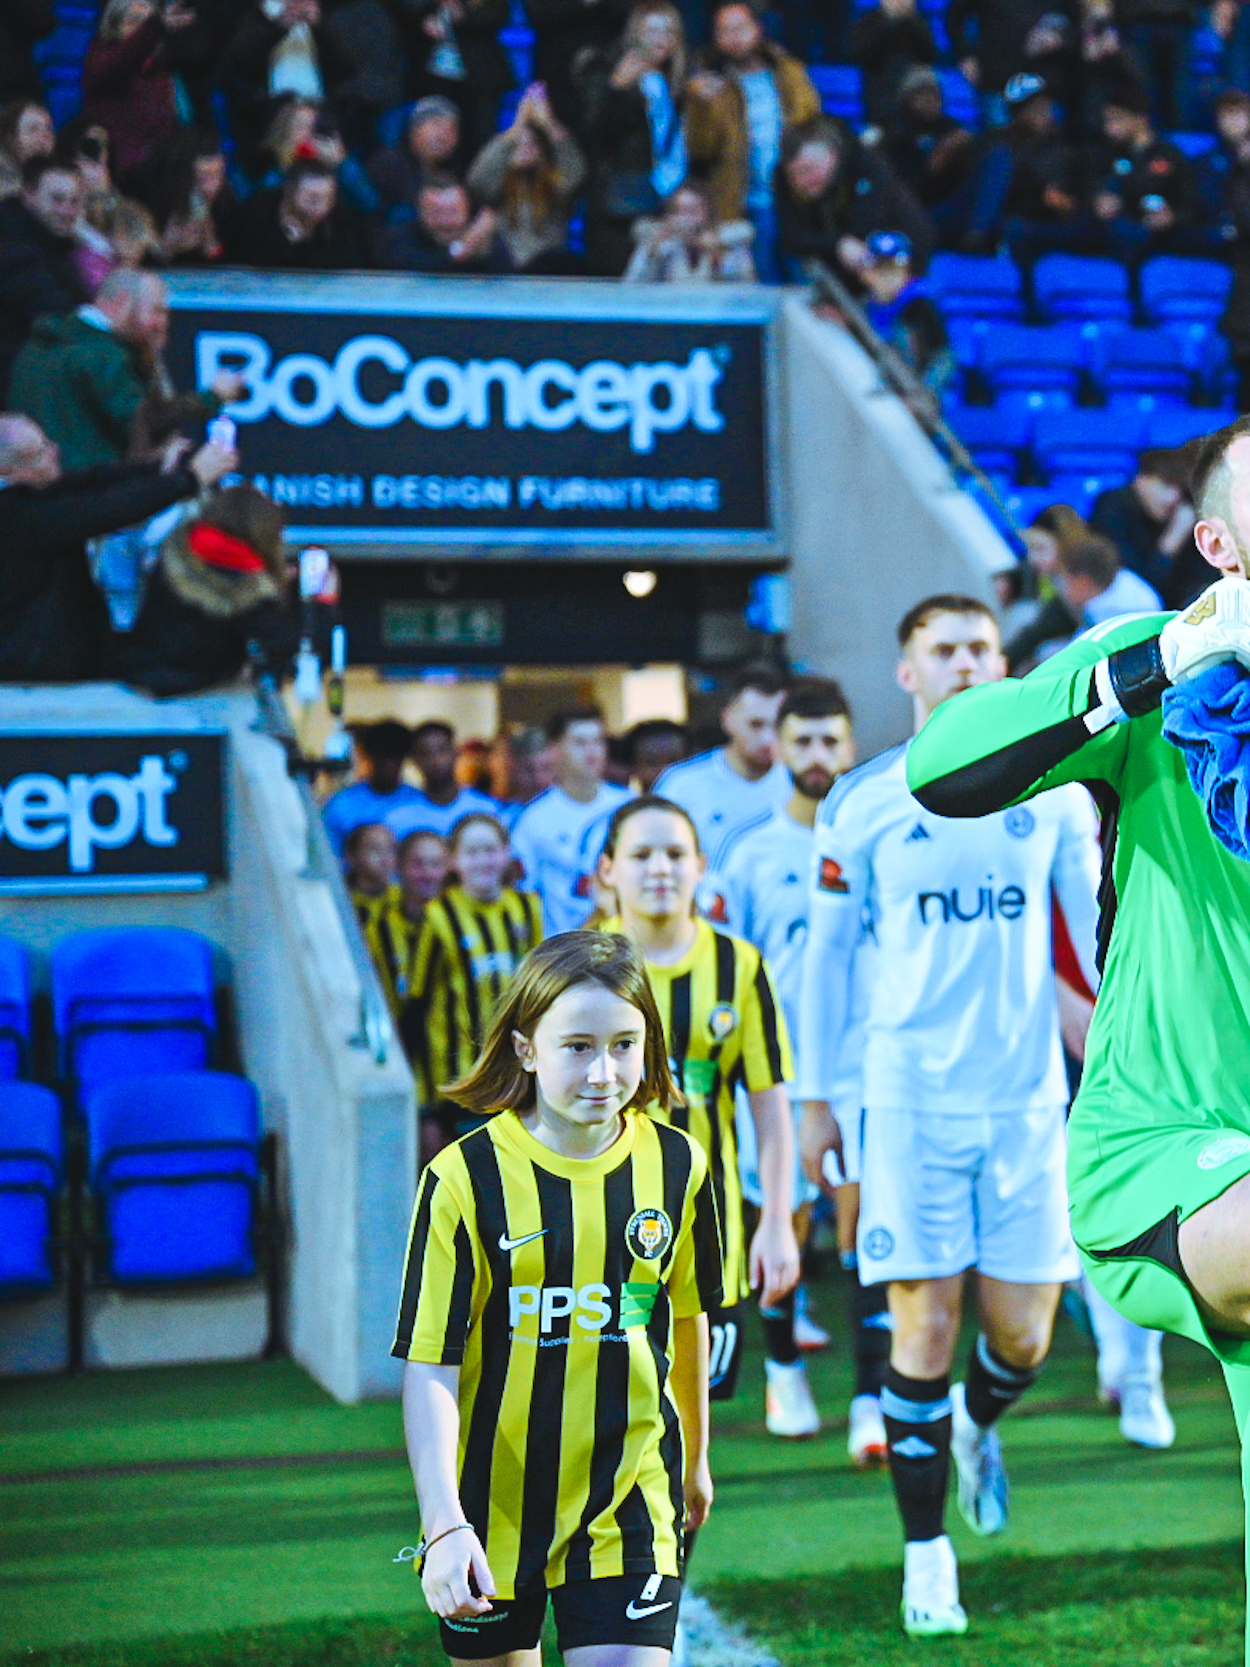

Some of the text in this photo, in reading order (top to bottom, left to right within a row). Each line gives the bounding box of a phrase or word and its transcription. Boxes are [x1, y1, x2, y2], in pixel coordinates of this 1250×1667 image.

[194, 328, 727, 454] BoConcept
[369, 474, 510, 509] DESIGN
[516, 476, 721, 511] FURNITURE
[0, 754, 180, 873] ept
[918, 874, 1026, 925] nuie
[508, 1283, 613, 1333] PPS
